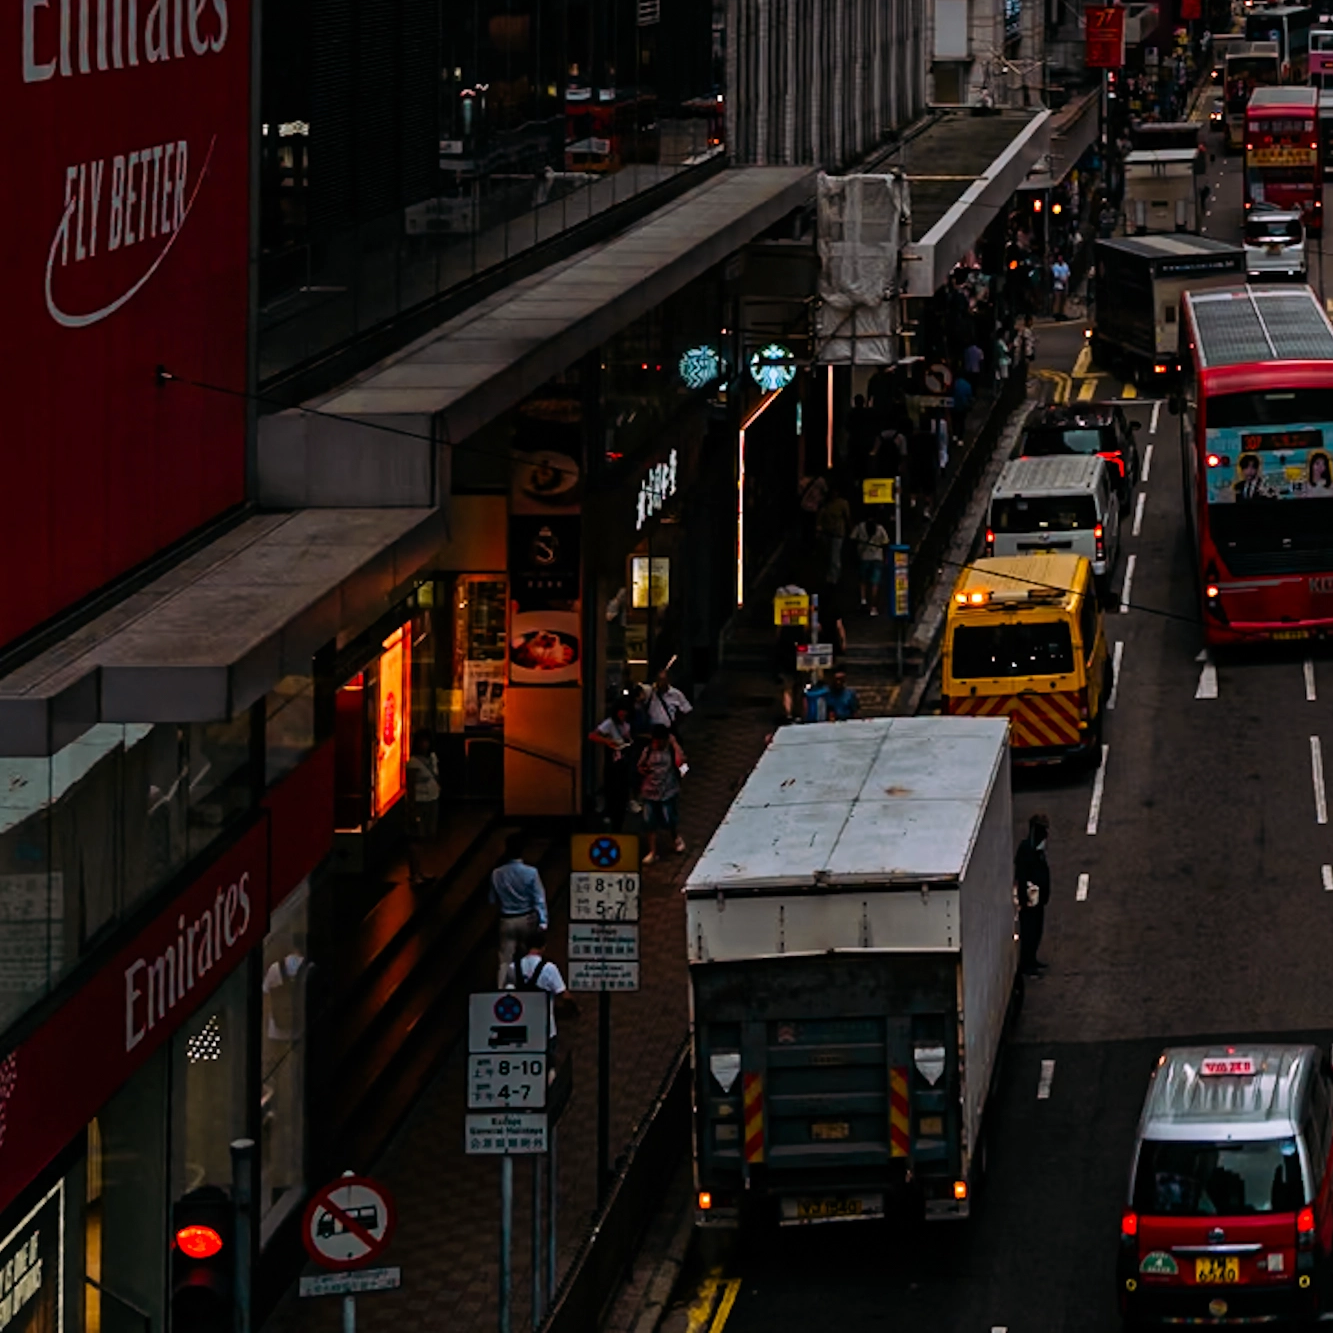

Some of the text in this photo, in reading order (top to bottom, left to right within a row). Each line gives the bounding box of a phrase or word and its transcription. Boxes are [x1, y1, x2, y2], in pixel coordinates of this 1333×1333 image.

[62, 140, 187, 266] FLY BETTER
[124, 871, 250, 1053] Emirates
[498, 1085, 531, 1099] 4-7
[499, 1060, 542, 1075] 8-10
